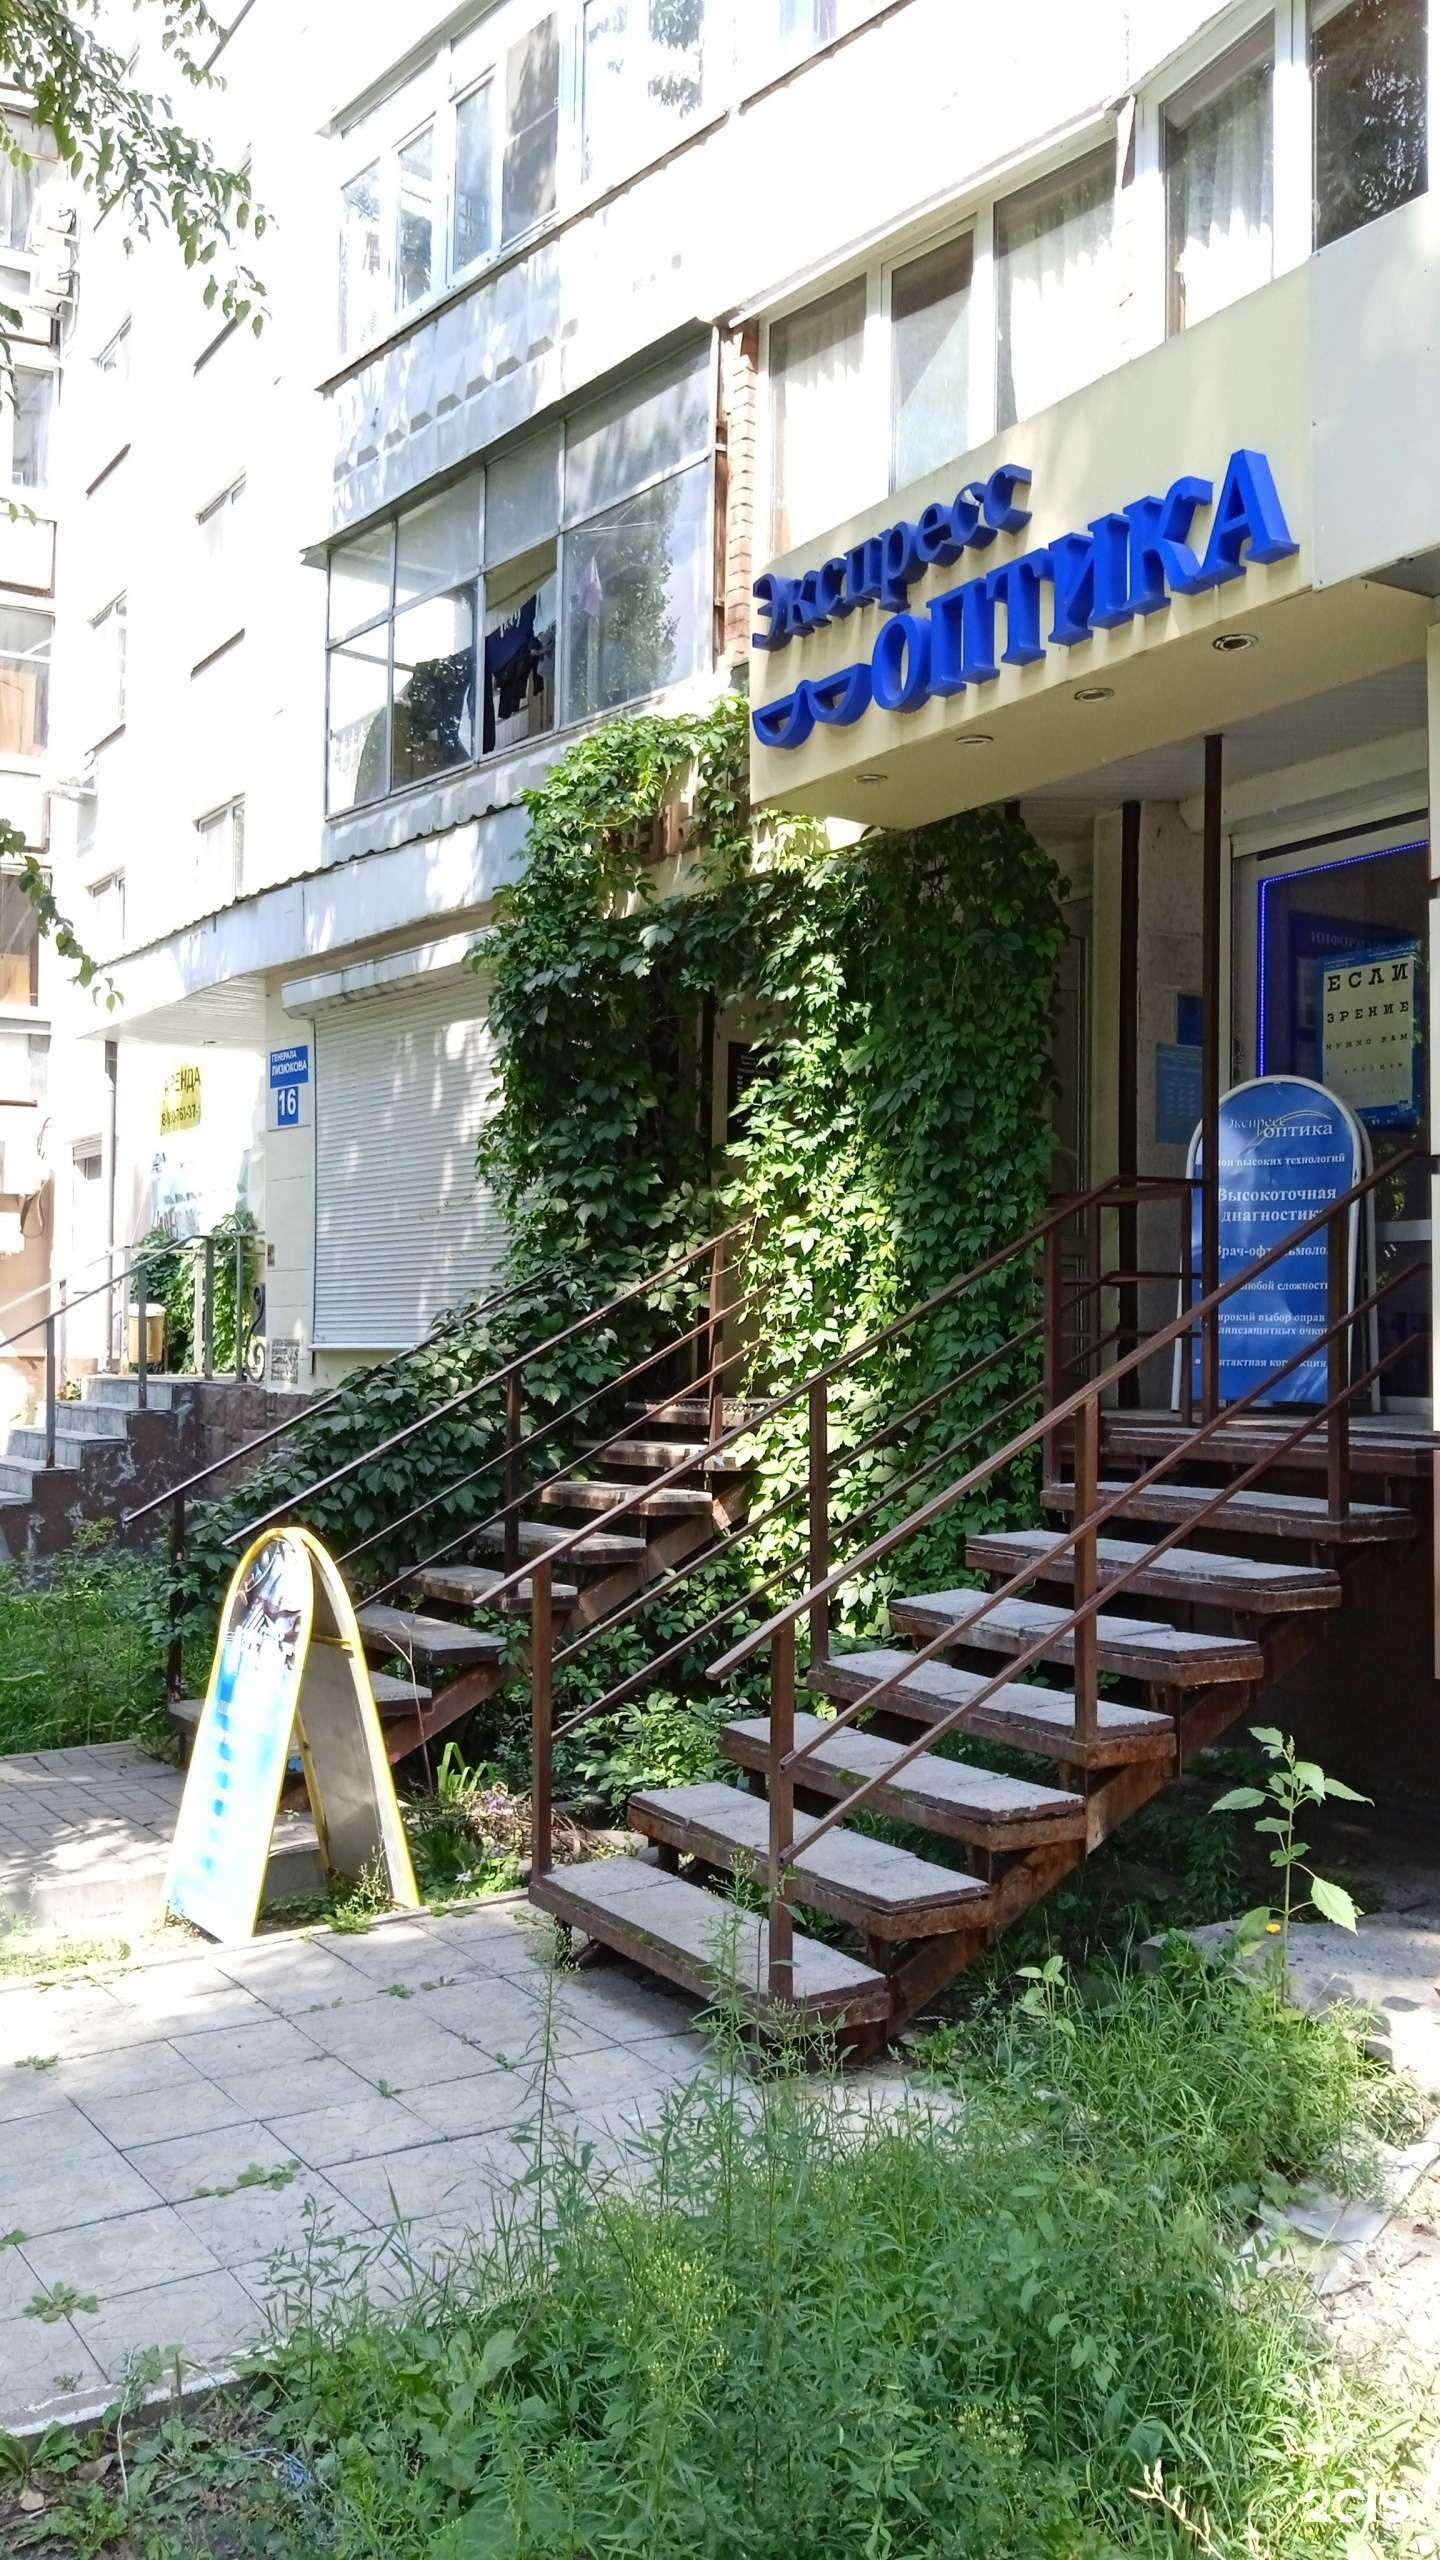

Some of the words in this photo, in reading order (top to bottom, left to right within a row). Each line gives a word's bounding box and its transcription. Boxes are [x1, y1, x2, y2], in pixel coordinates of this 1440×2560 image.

[872, 448, 1300, 713] ОПТИКА
[1327, 962, 1409, 992] ЕСЛИ
[1327, 1000, 1409, 1024] ЗРЕНИЕ
[271, 1049, 297, 1062] ГЕНЕРАЛА
[271, 1060, 308, 1077] ЛИЗЮКОВА
[279, 1088, 296, 1117] 16
[1263, 1124, 1333, 1138] оптика
[1237, 1157, 1283, 1167] высоких
[1285, 1152, 1346, 1166] технологий
[1218, 1187, 1337, 1203] Высокоточная
[1220, 1209, 1323, 1223] диагностик
[1258, 1312, 1292, 1324] выбор
[1293, 1313, 1325, 1324] оправ
